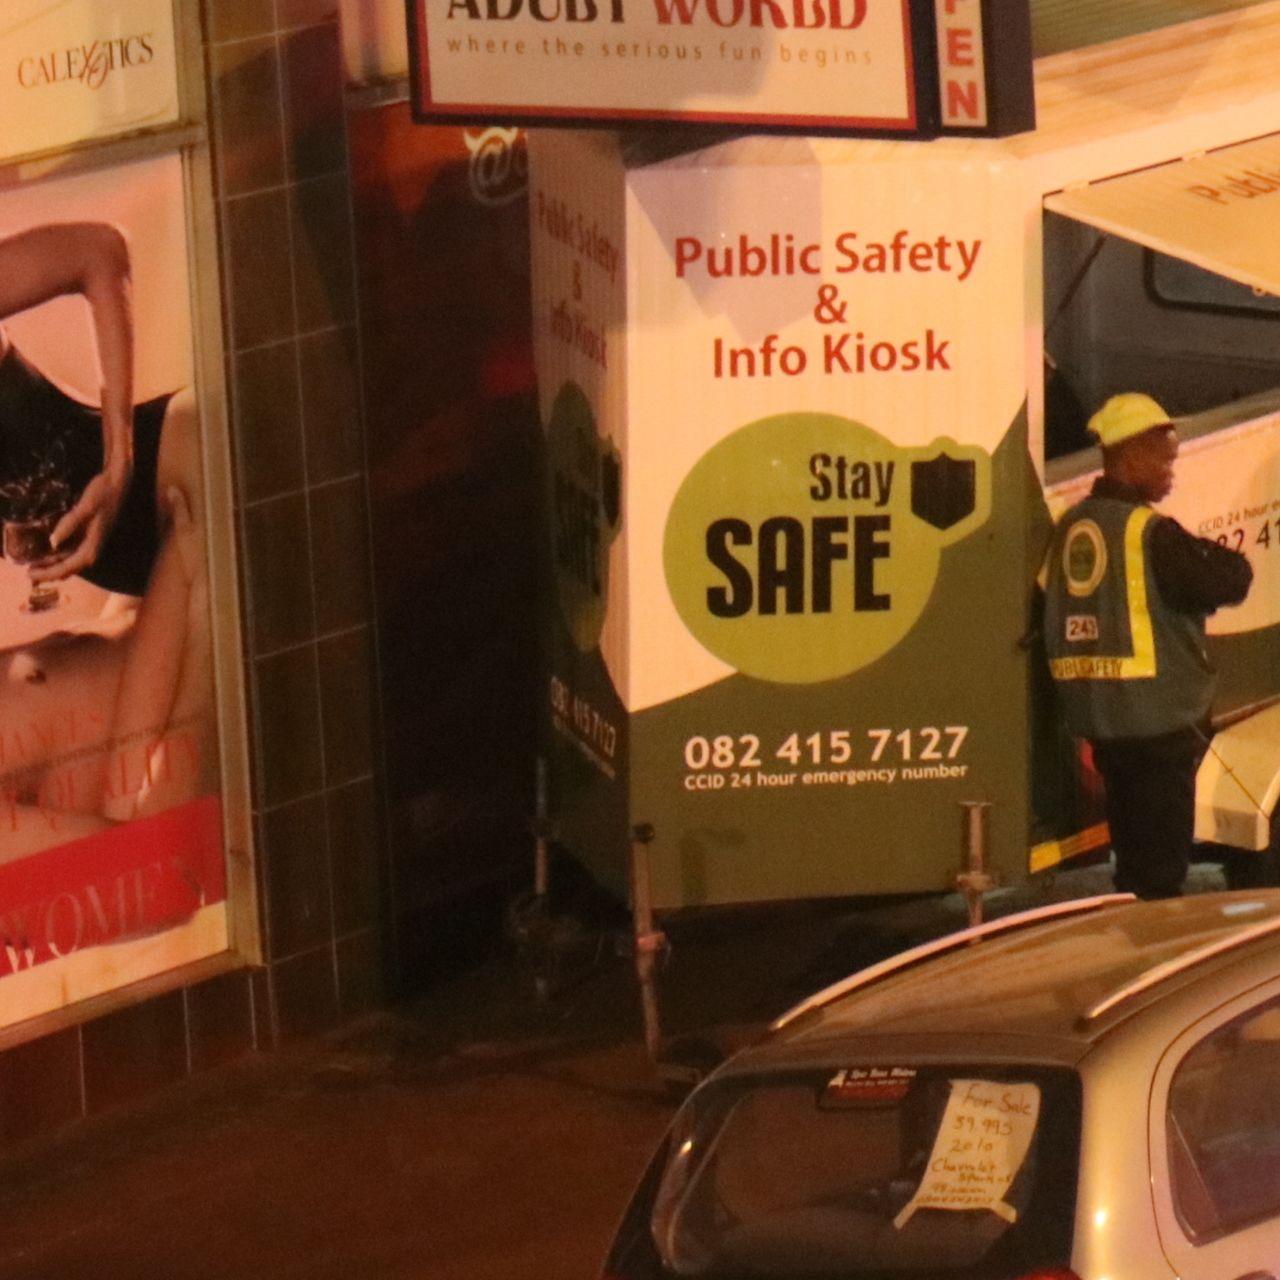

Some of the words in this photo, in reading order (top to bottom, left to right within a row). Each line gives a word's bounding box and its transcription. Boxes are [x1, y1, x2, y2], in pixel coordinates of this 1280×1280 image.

[18, 31, 154, 90] CALEXOTICS
[447, 34, 526, 55] where
[543, 37, 584, 56] the
[602, 40, 702, 61] serious
[719, 40, 762, 61] fun
[780, 43, 873, 68] begins
[674, 234, 821, 278] Public
[835, 230, 983, 281] Safety
[813, 284, 849, 324] &
[713, 334, 807, 378] Info
[824, 329, 951, 374] Kiosk
[809, 452, 895, 507] Stay
[705, 515, 892, 620] SAFE
[684, 734, 762, 769] 082
[776, 730, 852, 765] 415
[867, 725, 969, 762] 7127
[684, 773, 725, 790] CCID
[731, 772, 752, 788] 24
[757, 771, 797, 787] hour
[802, 767, 896, 786] emergency
[902, 763, 969, 780] number
